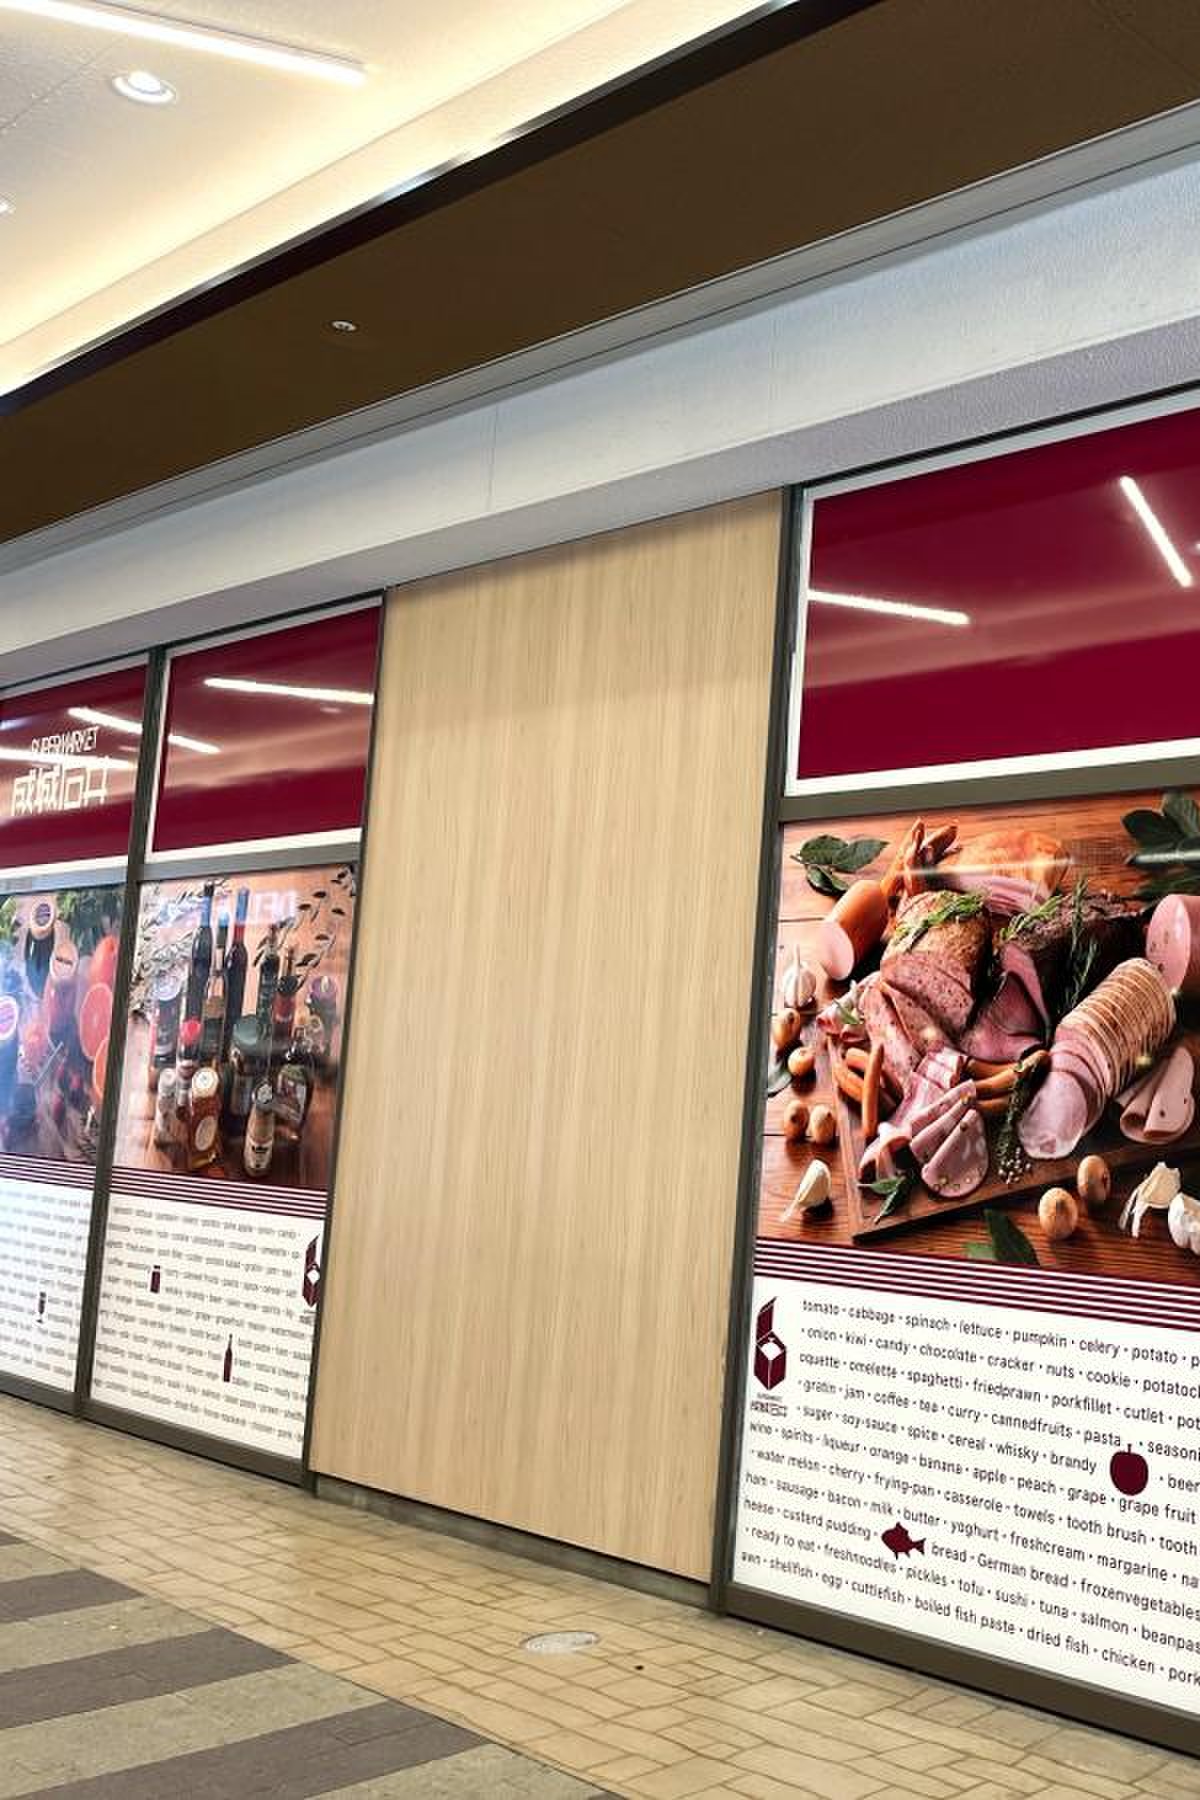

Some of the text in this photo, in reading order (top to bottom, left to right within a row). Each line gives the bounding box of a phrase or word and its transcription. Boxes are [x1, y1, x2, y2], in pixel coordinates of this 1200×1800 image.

[986, 1354, 1035, 1372] cracker
[1045, 1364, 1075, 1379] nuts
[1085, 1370, 1131, 1388] cookie
[1012, 1329, 1067, 1348] pumpkin
[1078, 1338, 1121, 1359] celery
[1131, 1346, 1179, 1365] potato
[972, 1376, 1041, 1403] friedprawn
[1050, 1394, 1112, 1415] porkfillet
[1122, 1406, 1164, 1425] cutlet
[947, 1404, 981, 1424] curry
[990, 1412, 1073, 1439] cannedfruits
[1083, 1429, 1121, 1447] pasta
[995, 1441, 1039, 1465] whisky
[1049, 1449, 1097, 1476] brandy
[1167, 1472, 1200, 1493] beer
[828, 1462, 865, 1485] cherry
[943, 1489, 1003, 1513] casserole
[1012, 1503, 1055, 1525] towels
[1066, 1514, 1102, 1535] tooth
[1106, 1521, 1147, 1545] brush
[1158, 1535, 1197, 1557] tooth
[1016, 1476, 1056, 1495] peach
[1067, 1487, 1107, 1505] grape
[1118, 1497, 1159, 1517] grape
[1164, 1502, 1196, 1525] fruit
[950, 1520, 999, 1542] yoghurt
[1009, 1530, 1085, 1562] freshcream
[1096, 1554, 1168, 1582] margarine
[976, 1552, 1026, 1577] German
[1029, 1565, 1069, 1588] bread
[905, 1565, 948, 1587] pickles
[1080, 1611, 1129, 1635] salmon
[979, 1615, 1016, 1635] paste
[1026, 1626, 1061, 1648] dried
[1065, 1634, 1089, 1656] fish
[1100, 1647, 1155, 1675] chicken
